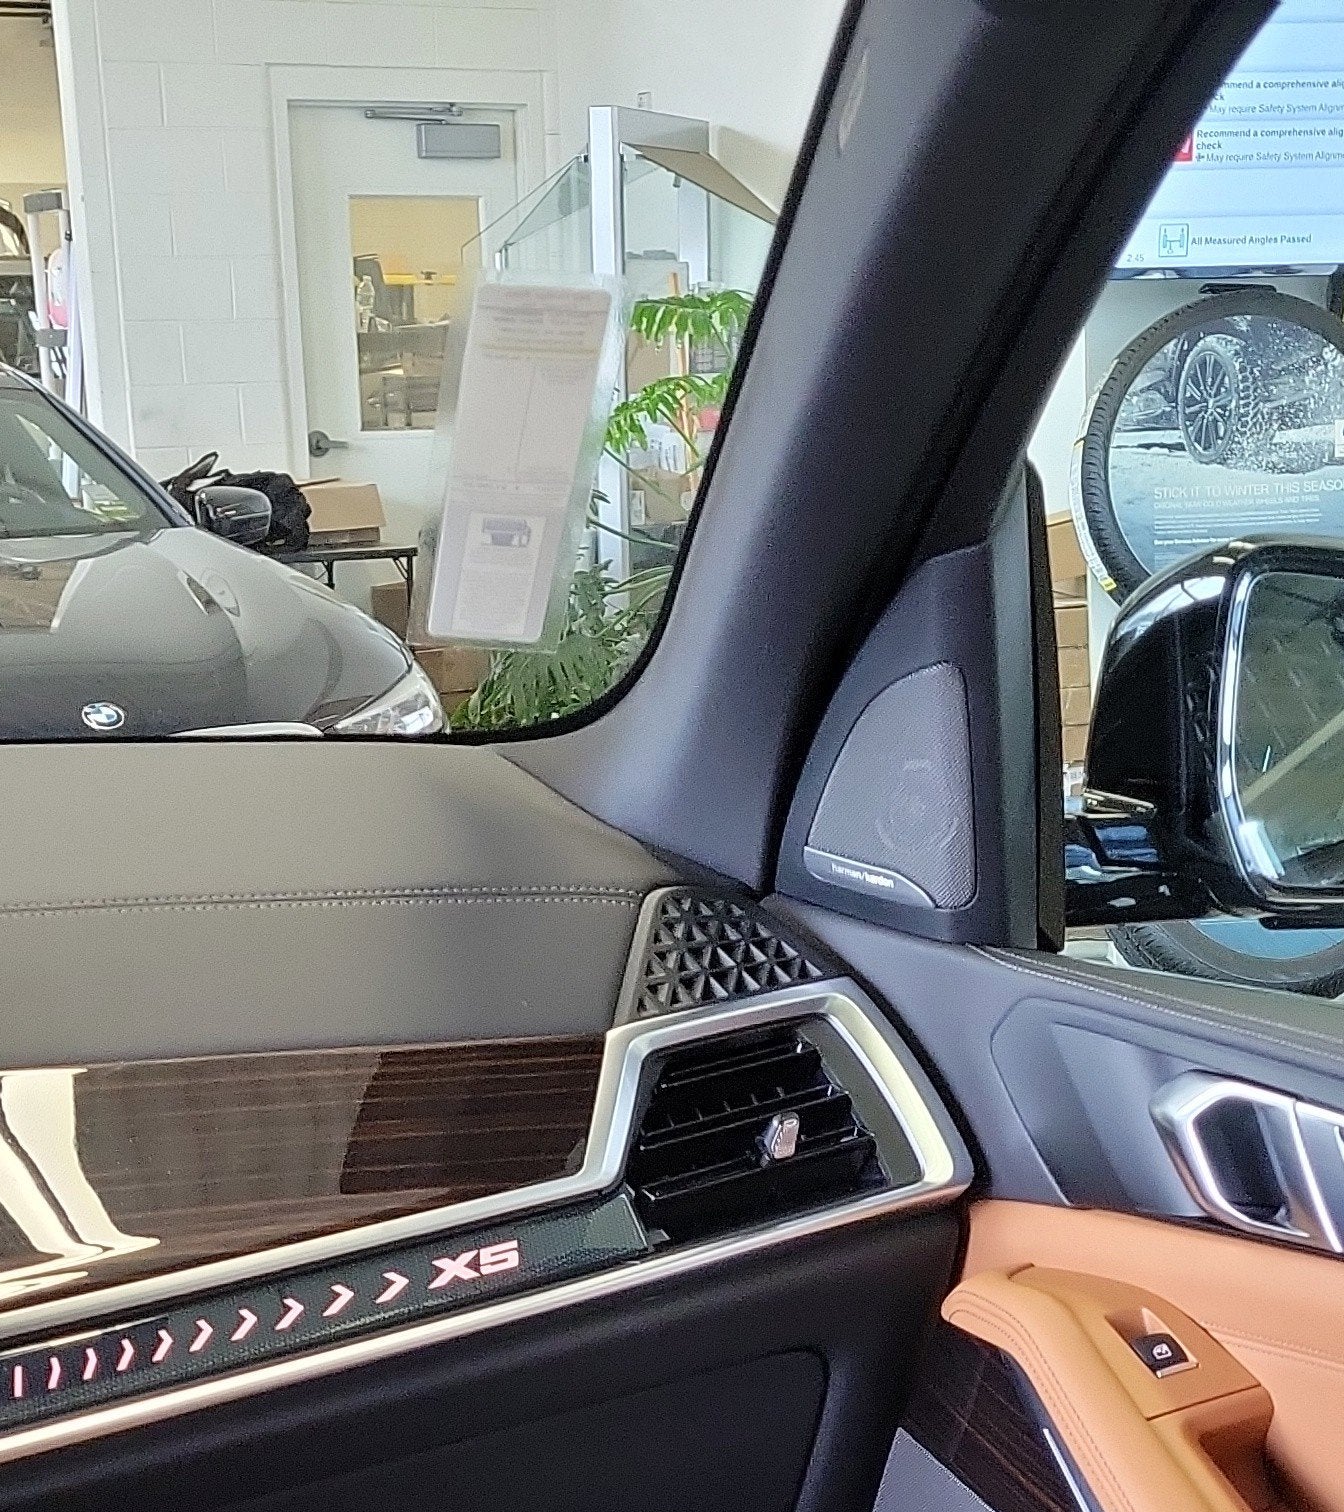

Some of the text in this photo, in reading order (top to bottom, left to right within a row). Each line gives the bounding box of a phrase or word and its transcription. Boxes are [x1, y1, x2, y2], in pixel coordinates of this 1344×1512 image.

[1263, 80, 1330, 91] comprehensive
[1228, 104, 1256, 114] require
[1258, 103, 1284, 113] Safety
[1286, 103, 1316, 113] System
[1197, 129, 1251, 138] Recommend
[1261, 128, 1326, 140] comprehensive
[1196, 141, 1222, 150] check
[1206, 151, 1313, 163] May require Safety System
[1191, 233, 1312, 246] All Measured Angles Passed
[1154, 486, 1187, 499] STICK
[1191, 485, 1200, 497] IT
[1205, 485, 1220, 497] TO
[1225, 483, 1269, 496] WINTER
[1275, 482, 1300, 494] THIS
[427, 1239, 520, 1290] X5
